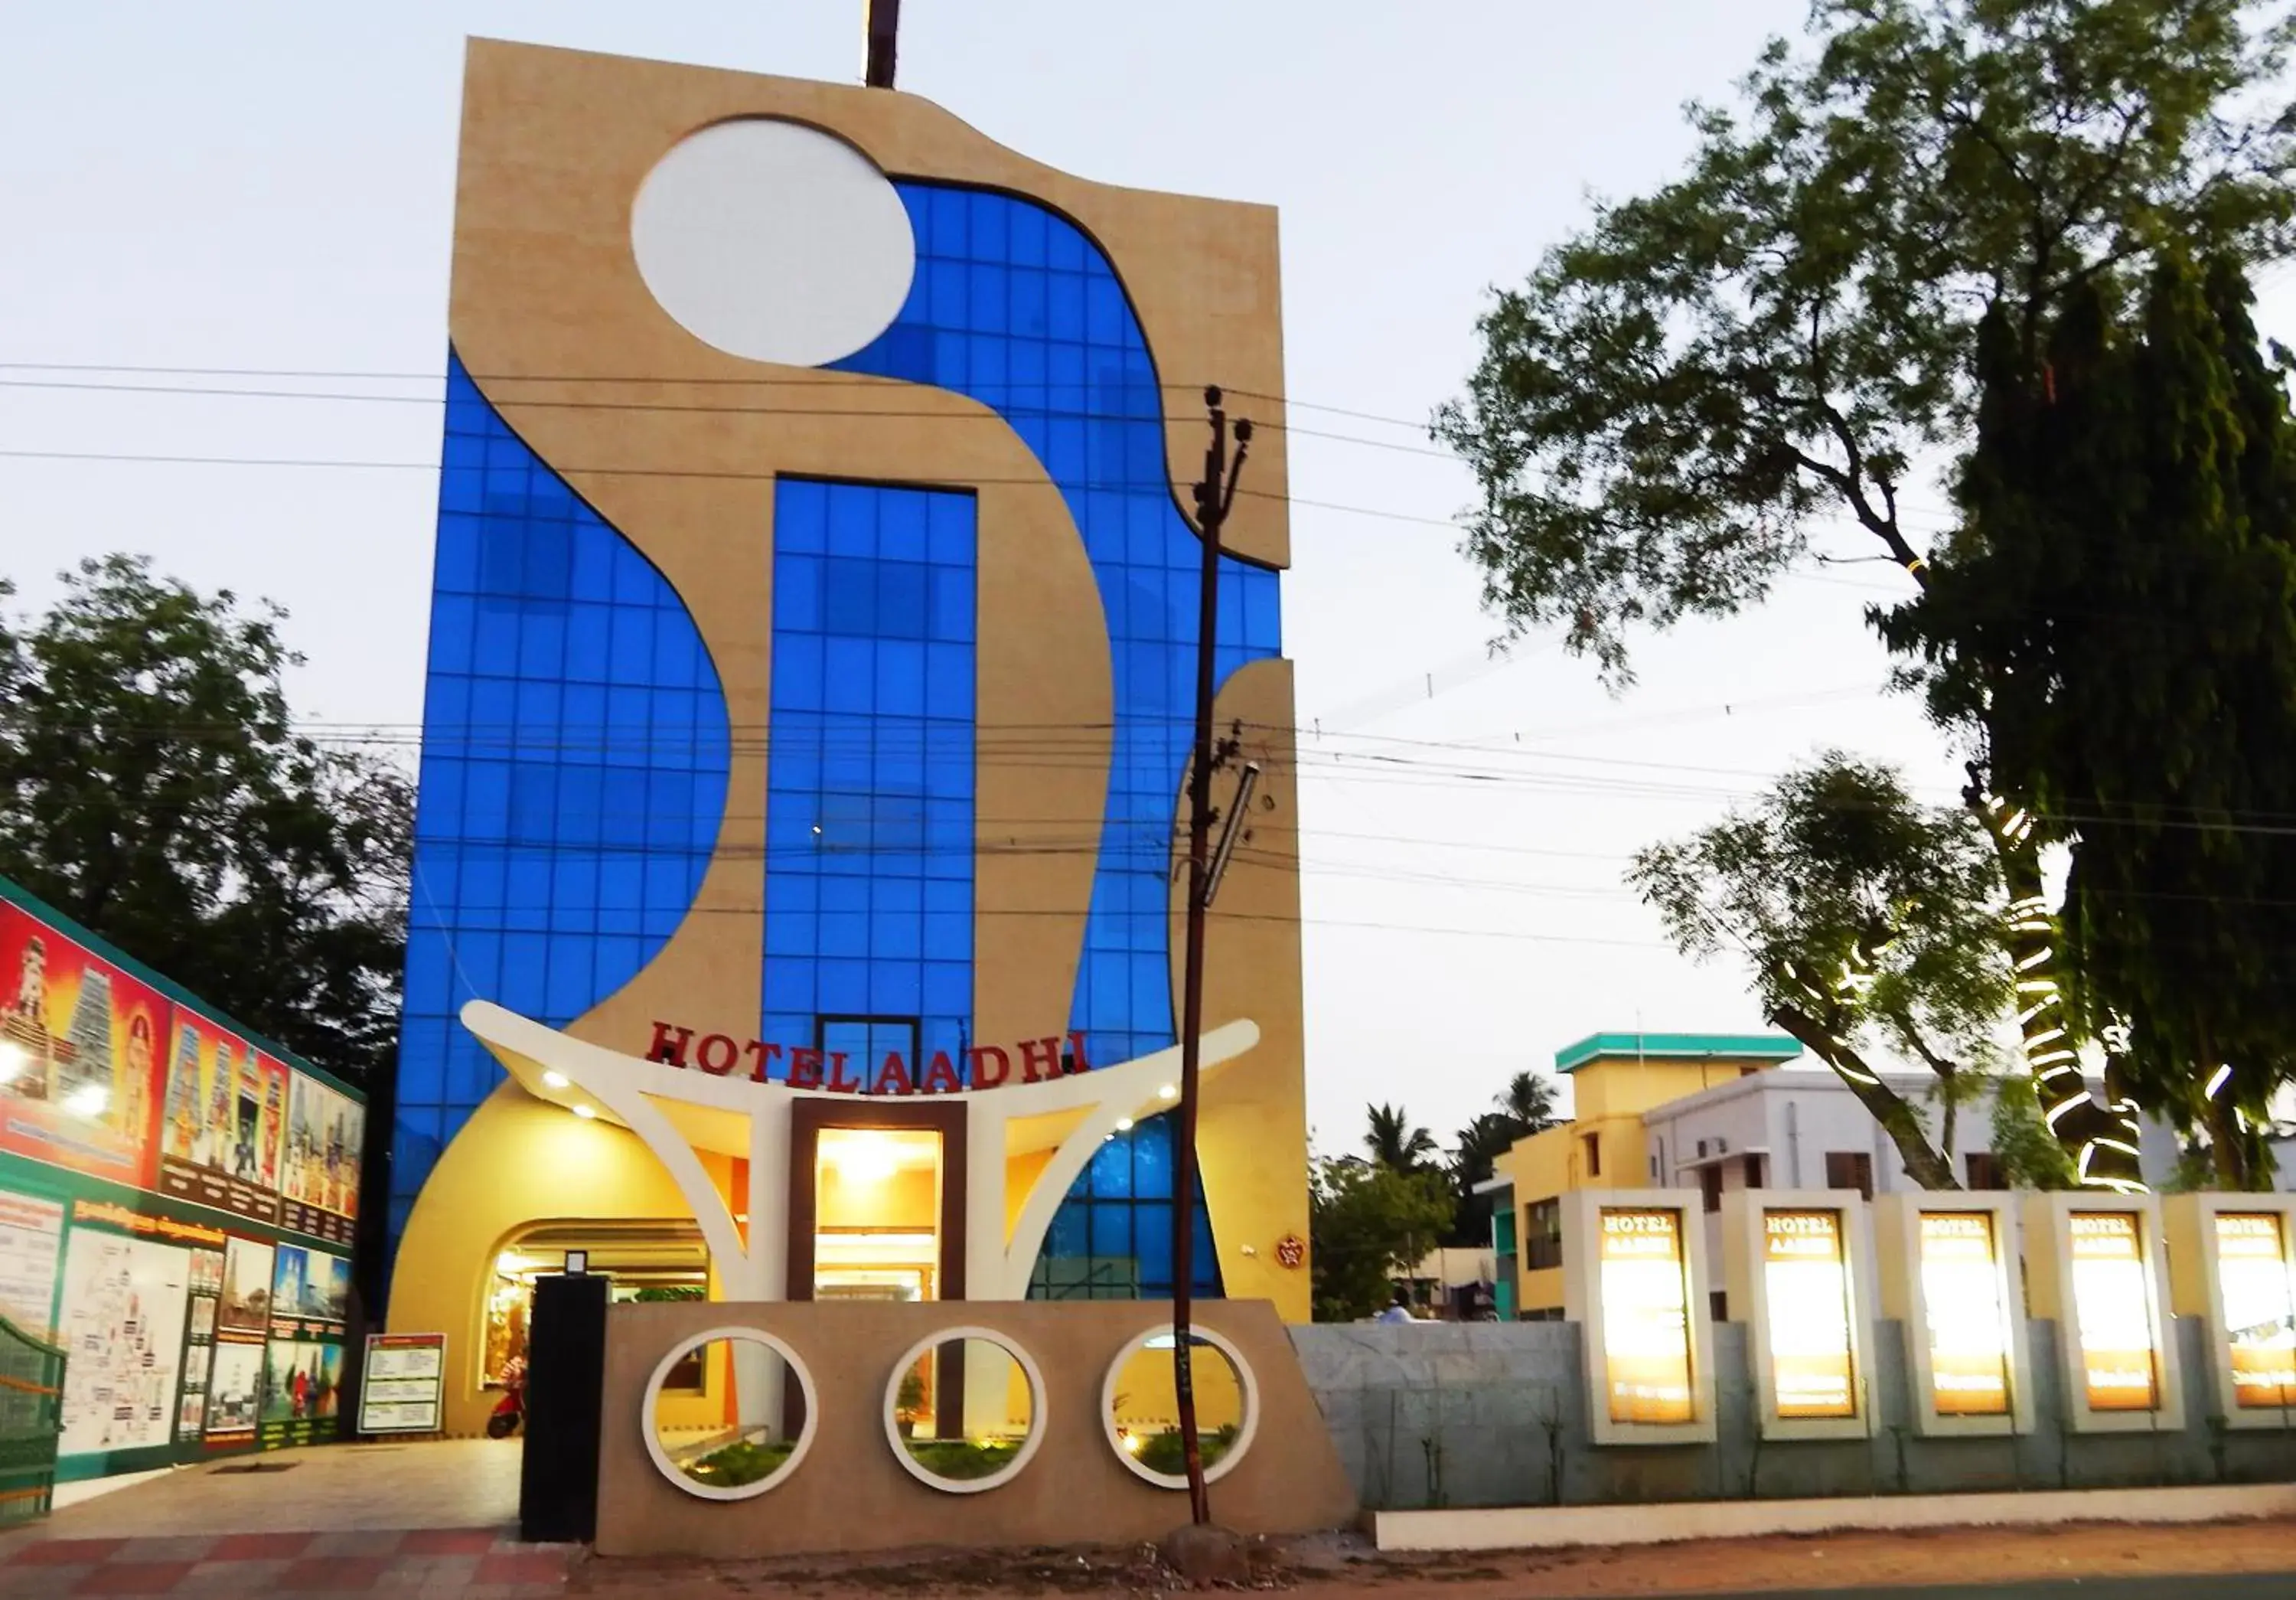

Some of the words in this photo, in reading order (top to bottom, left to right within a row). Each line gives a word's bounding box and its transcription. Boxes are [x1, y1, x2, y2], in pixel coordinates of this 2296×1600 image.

[645, 1020, 861, 1092] HOTEL
[872, 1031, 1092, 1096] AADHI
[1766, 1216, 1834, 1234] HOTEL
